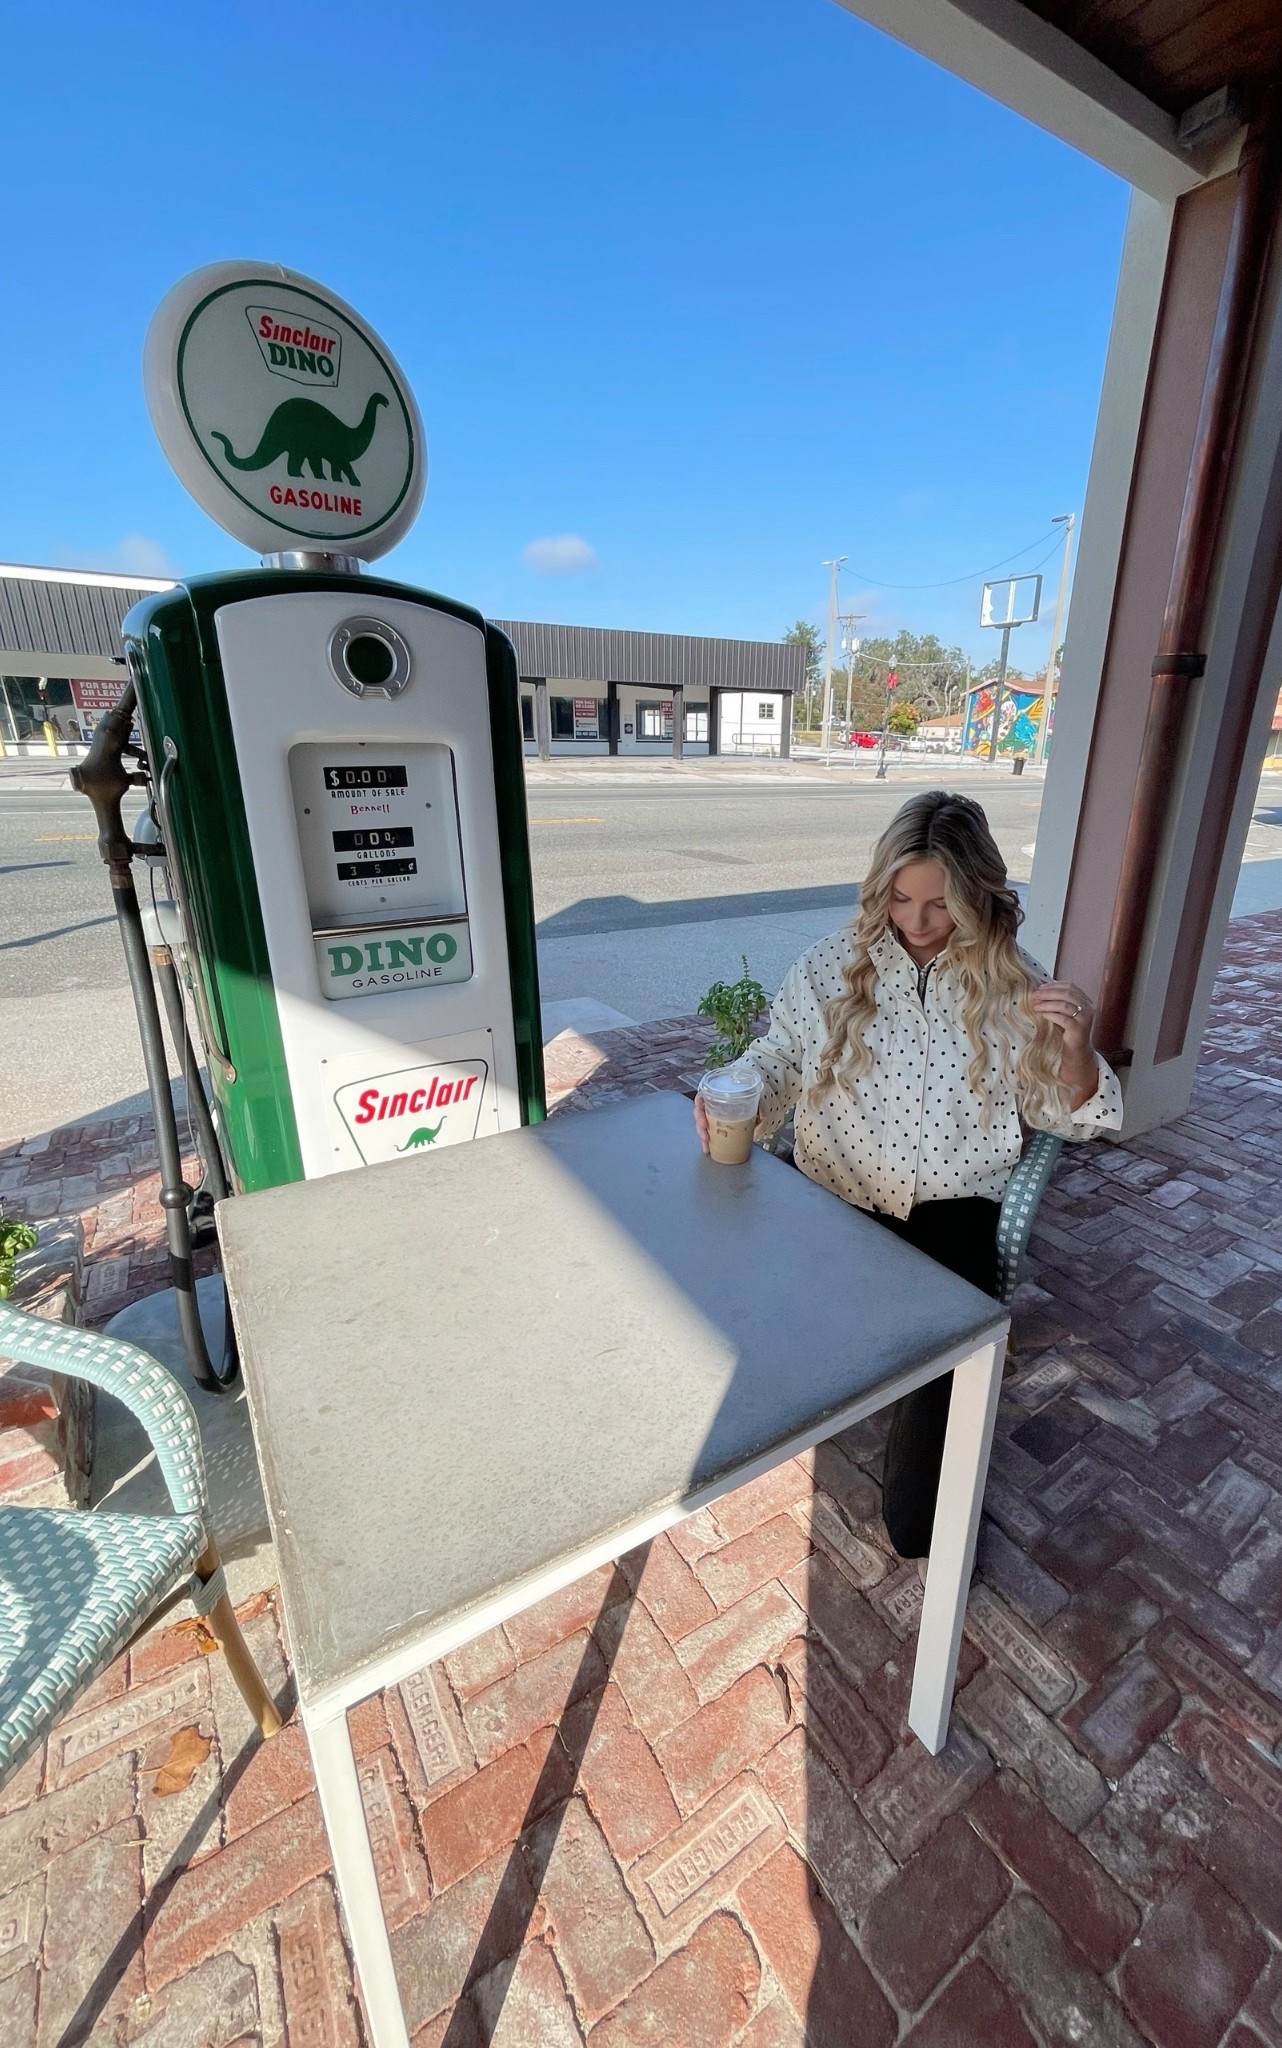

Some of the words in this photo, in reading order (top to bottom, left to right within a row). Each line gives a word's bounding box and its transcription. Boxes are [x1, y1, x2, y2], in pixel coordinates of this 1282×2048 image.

[258, 315, 336, 355] Sinclair
[268, 342, 334, 378] DINO
[269, 485, 362, 516] GASOLINE
[101, 682, 126, 690] SALE
[331, 789, 367, 799] AMOUNT
[371, 789, 381, 797] OF
[385, 788, 405, 796] SALE
[357, 849, 396, 859] GALLONS
[327, 932, 458, 977] DINO
[352, 967, 443, 989] GASOLINE
[354, 1075, 479, 1124] Sinclair
